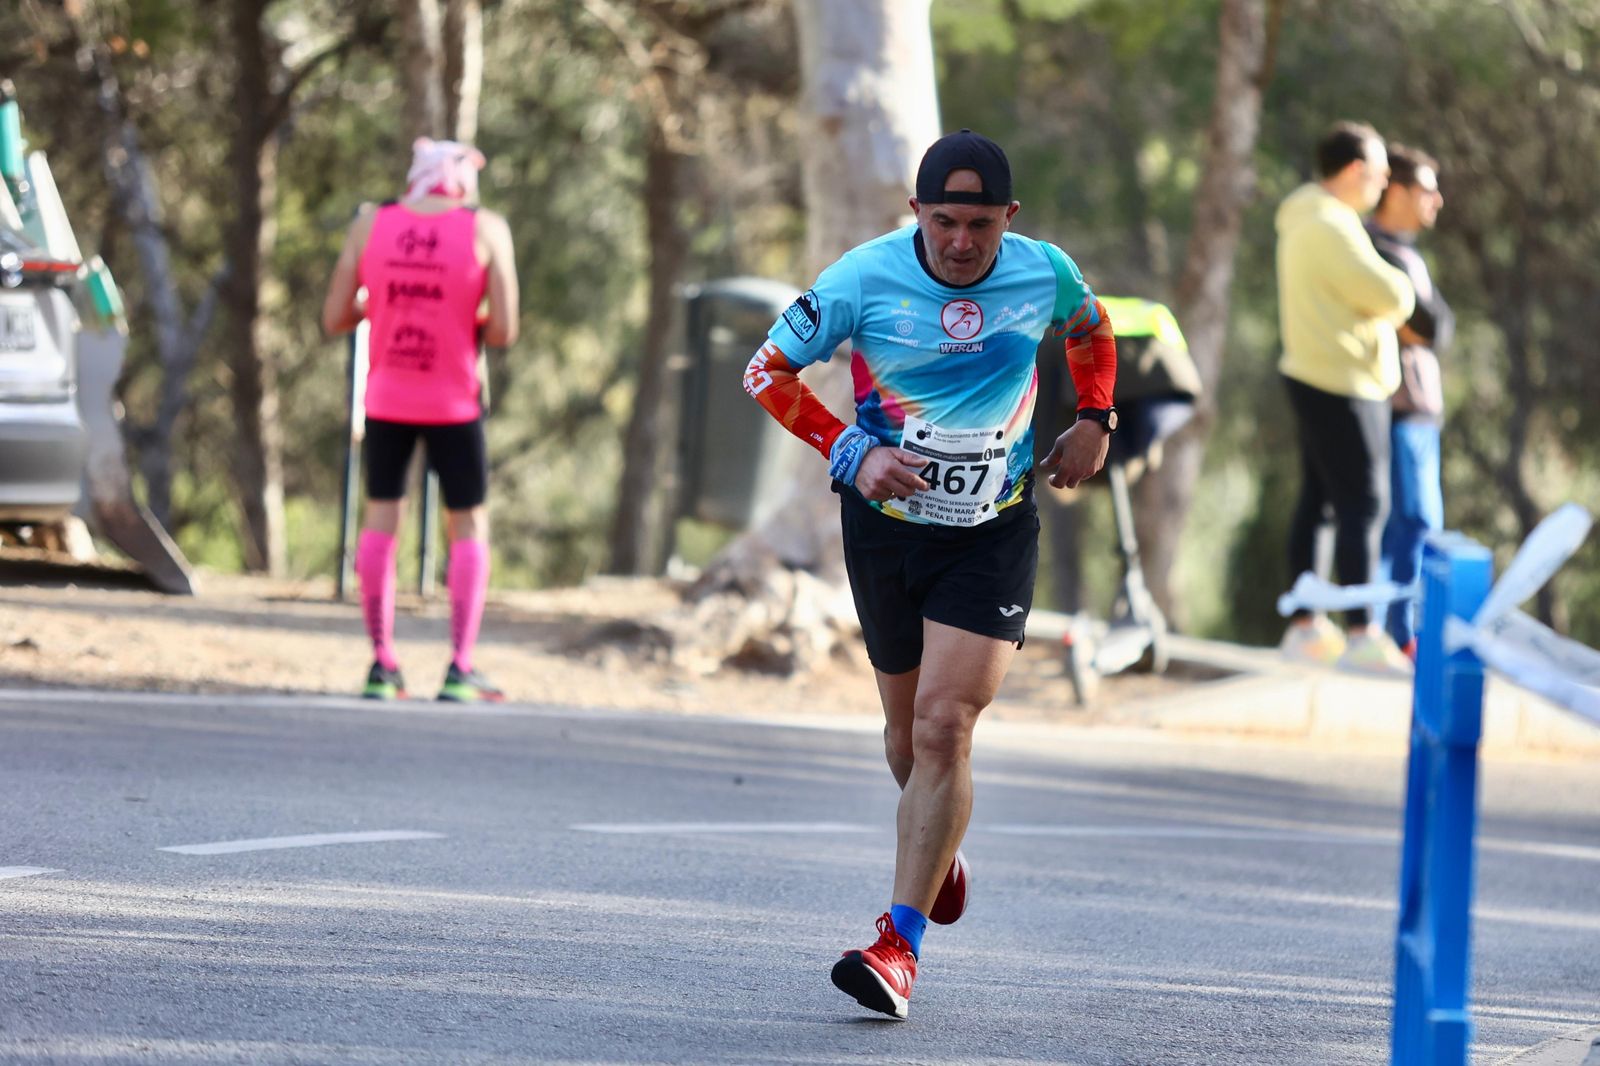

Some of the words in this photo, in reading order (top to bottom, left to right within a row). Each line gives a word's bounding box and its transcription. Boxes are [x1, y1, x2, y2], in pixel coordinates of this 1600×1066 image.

[940, 342, 983, 354] WERUN
[934, 430, 971, 439] Ayuntamiento
[919, 461, 990, 496] 467
[925, 495, 949, 505] ANTONIO
[937, 505, 953, 514] MINI
[925, 510, 945, 521] PEÑA
